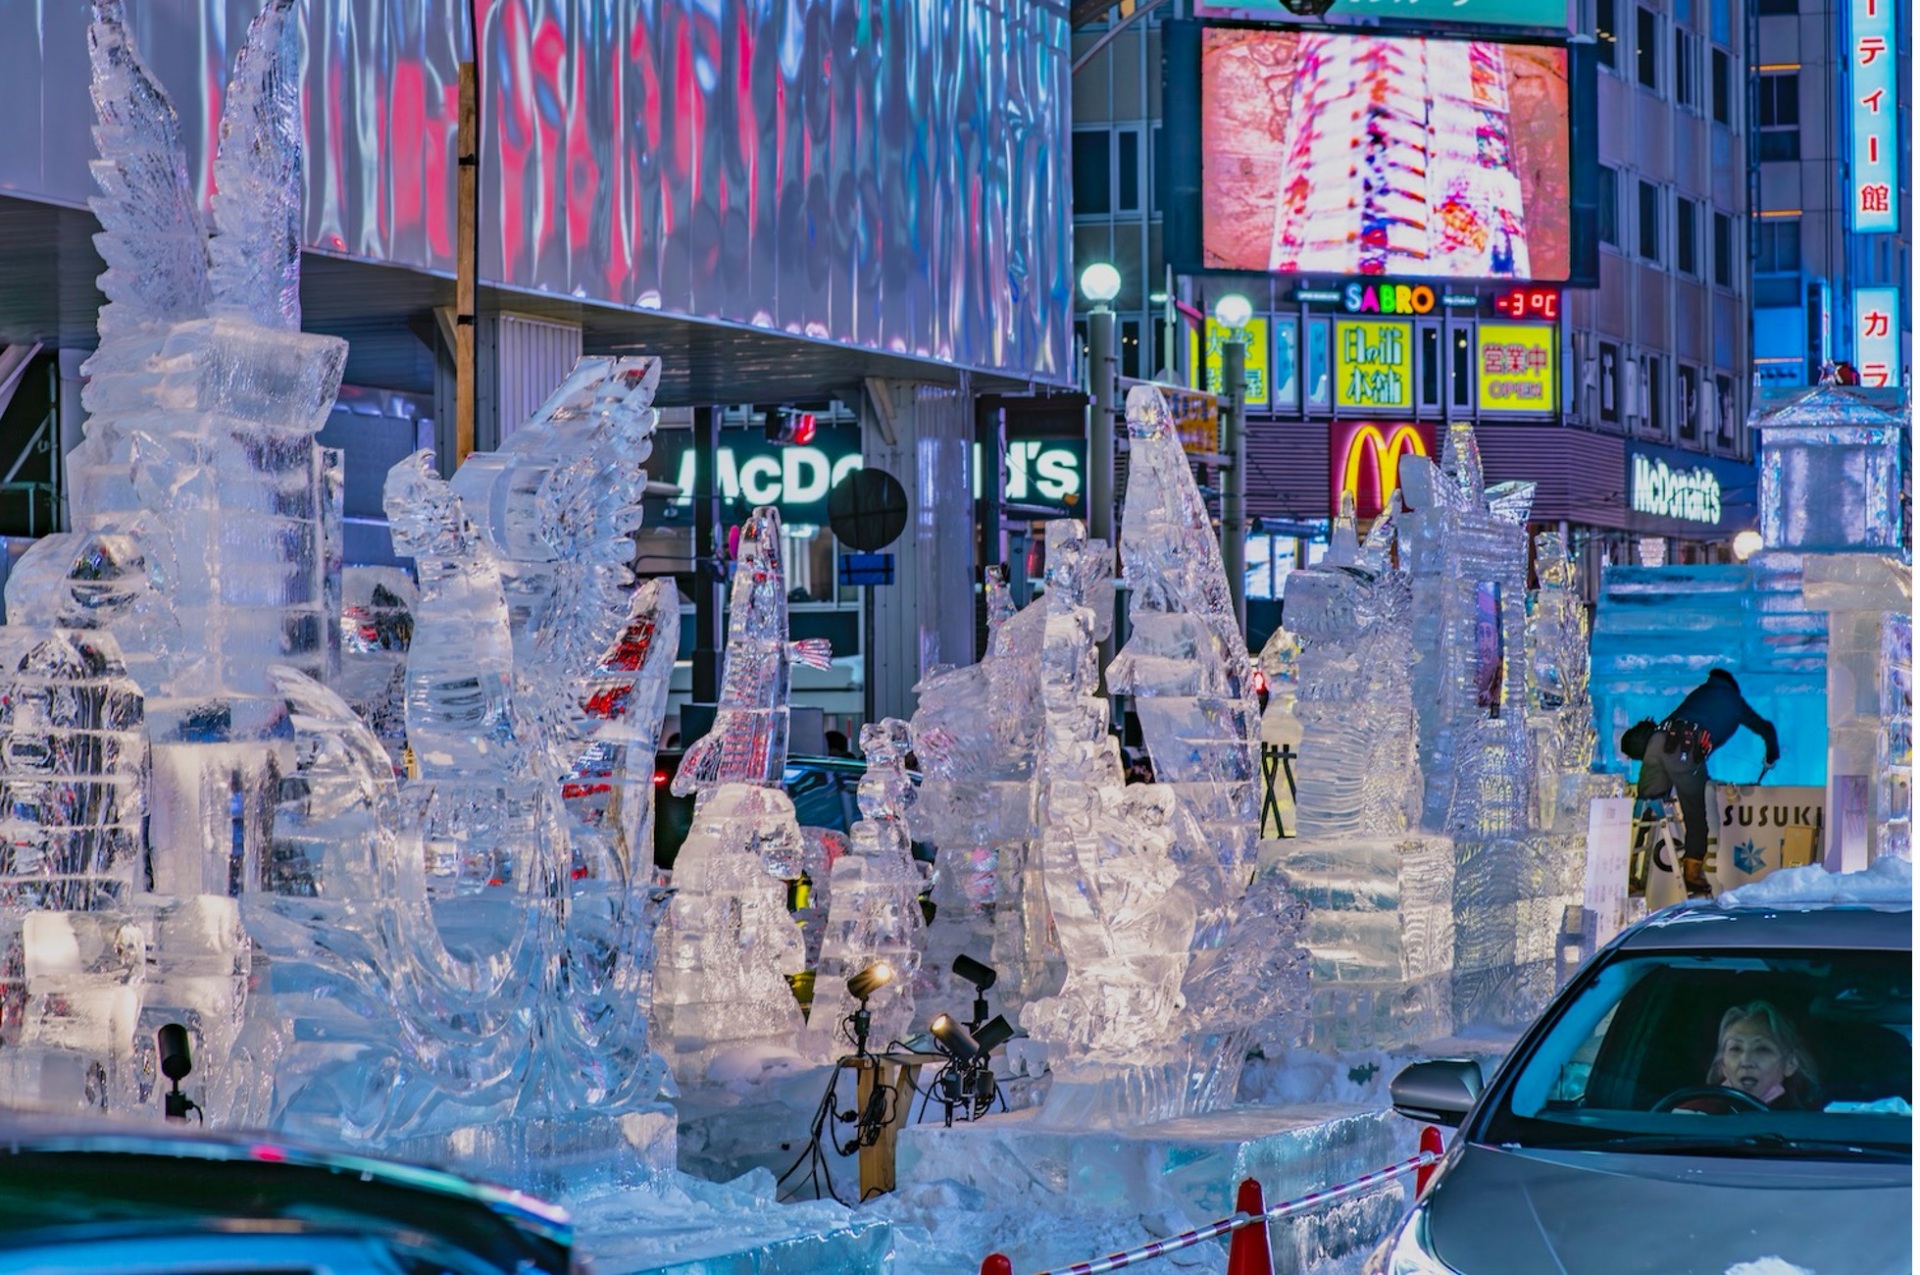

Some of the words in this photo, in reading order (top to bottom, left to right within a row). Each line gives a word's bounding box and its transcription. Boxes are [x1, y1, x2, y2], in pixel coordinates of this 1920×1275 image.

[1345, 282, 1434, 314] SABRO
[1482, 343, 1547, 376] 営業中
[1863, 311, 1888, 387] カラ
[1488, 381, 1543, 400] OPEN
[1633, 456, 1721, 525] McDonald's
